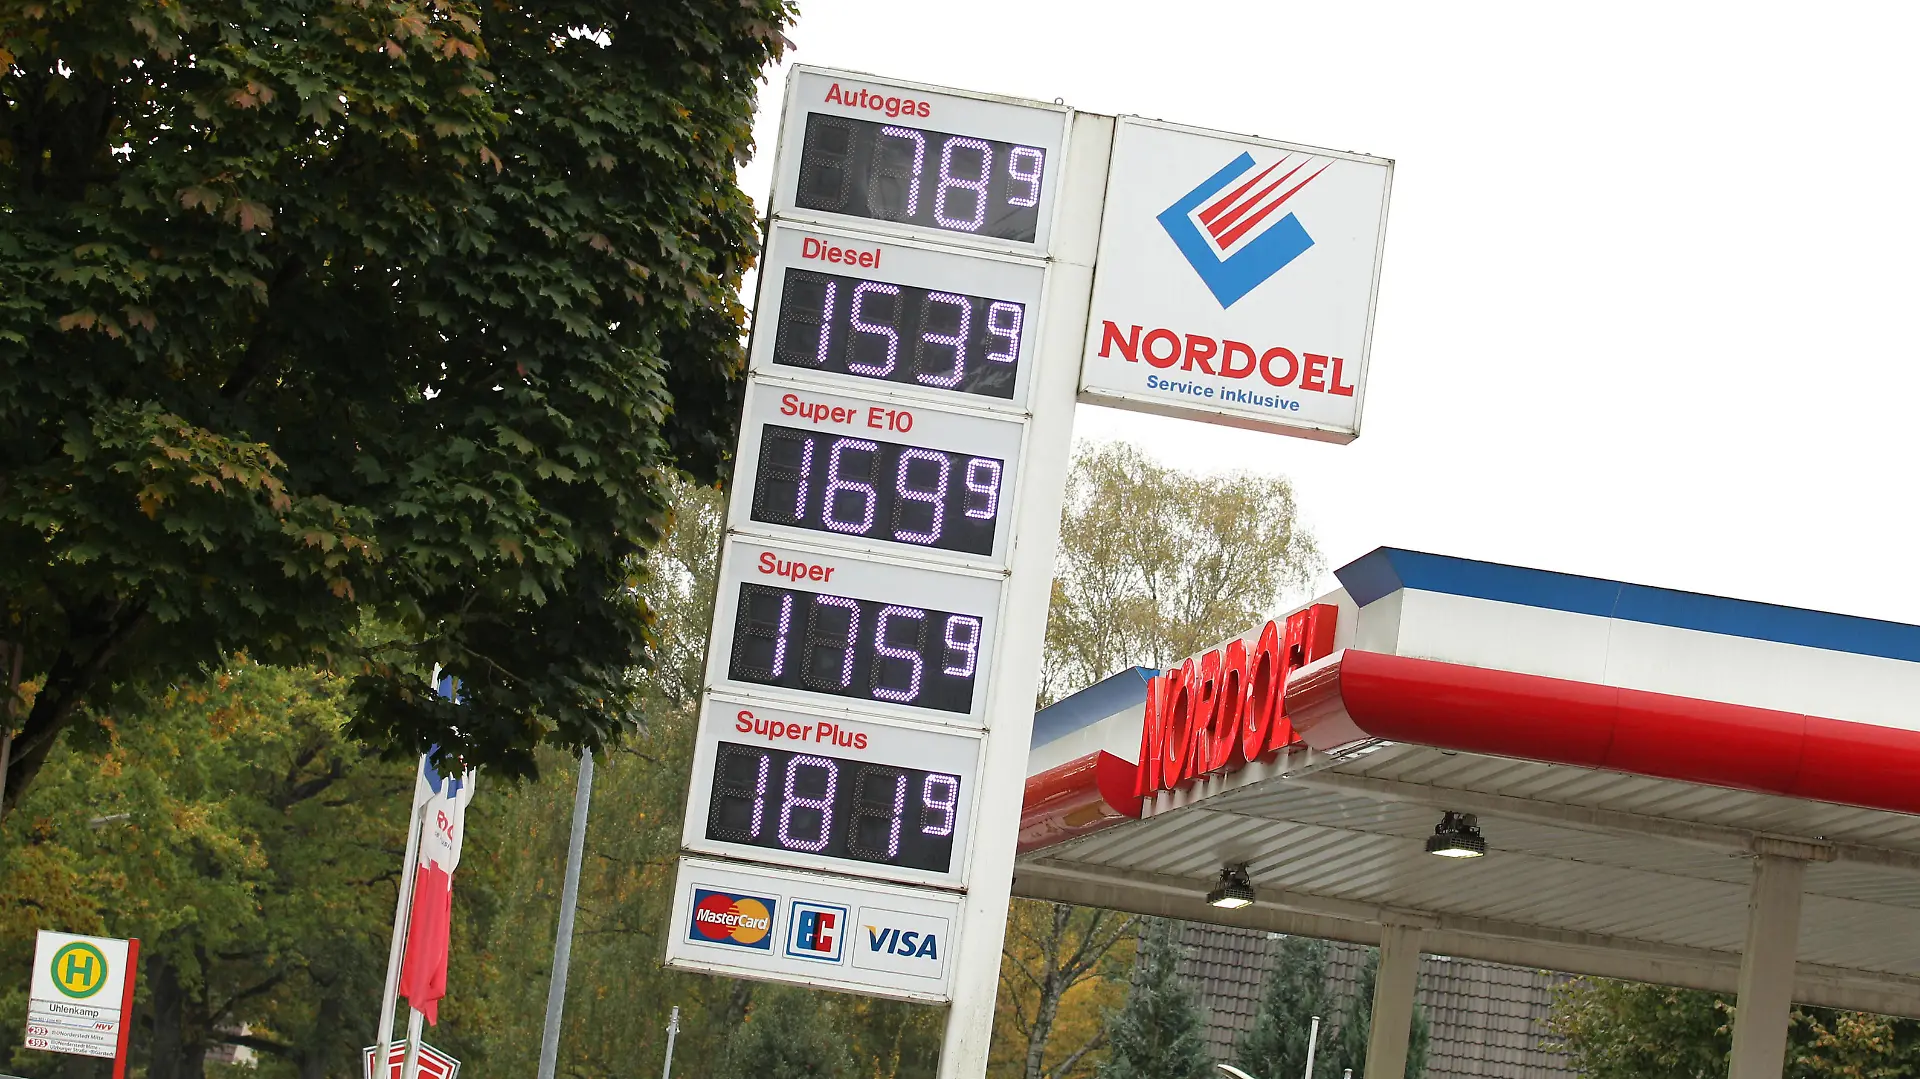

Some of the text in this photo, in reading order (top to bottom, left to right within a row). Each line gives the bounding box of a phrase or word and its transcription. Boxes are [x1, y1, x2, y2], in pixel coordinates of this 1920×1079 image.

[826, 83, 931, 117] Autogas
[802, 238, 881, 268] Diesel
[1098, 320, 1355, 397] NORDOEL
[1147, 375, 1300, 411] Service inklusive
[780, 394, 913, 433] Super E10
[758, 552, 835, 582] Super
[735, 710, 869, 750] Super Plus
[696, 908, 768, 930] MasterCard
[863, 924, 937, 960] VISA
[65, 954, 94, 986] H
[49, 1003, 99, 1018] Uhlenkamp
[31, 1026, 46, 1036] 293
[95, 1022, 114, 1031] HVV
[31, 1039, 47, 1049] 393
